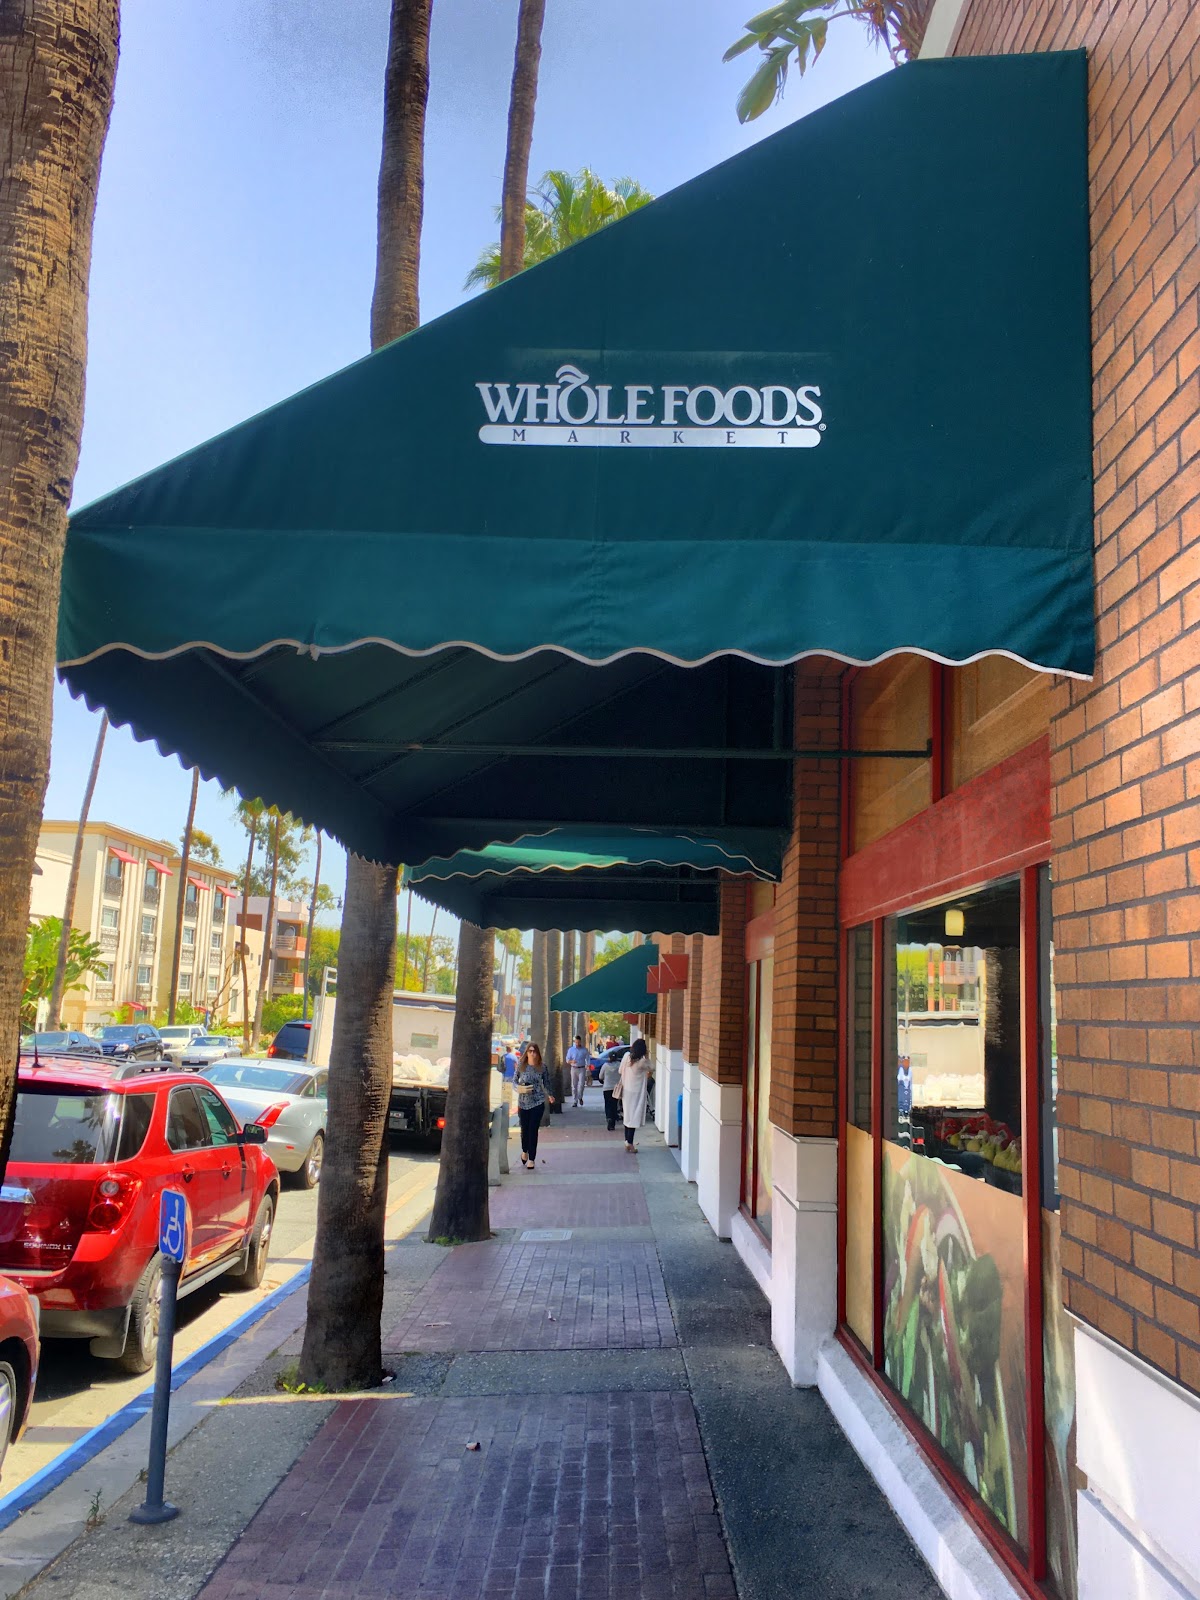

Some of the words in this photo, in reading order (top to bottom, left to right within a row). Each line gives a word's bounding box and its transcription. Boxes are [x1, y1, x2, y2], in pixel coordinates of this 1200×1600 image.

[475, 364, 655, 425] WHOLE
[660, 385, 823, 427] FOODS
[511, 428, 790, 445] MARKET
